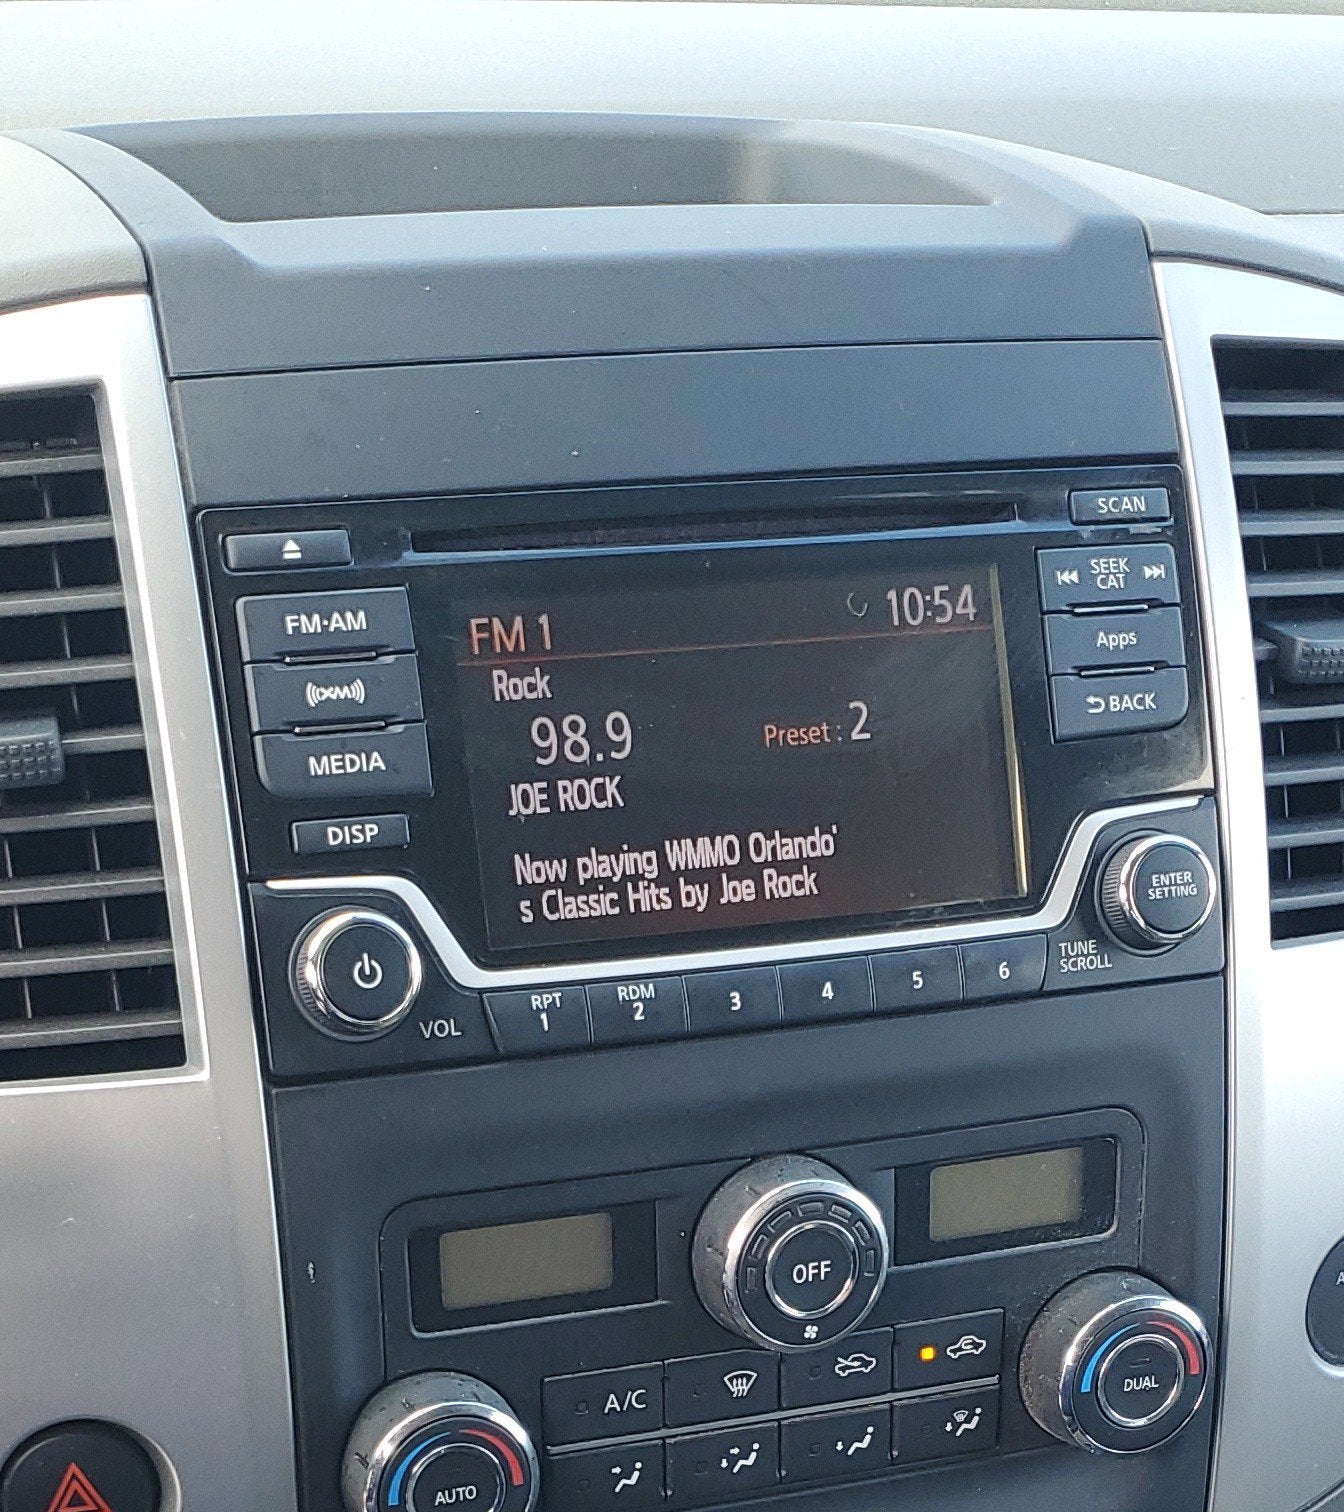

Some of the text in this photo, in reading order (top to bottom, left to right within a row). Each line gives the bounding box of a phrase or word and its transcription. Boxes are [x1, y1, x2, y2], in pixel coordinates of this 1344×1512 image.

[1097, 496, 1146, 513] SCAN
[1090, 558, 1129, 574] SEEK
[1097, 573, 1125, 590] CAT
[887, 584, 977, 626] 10:54
[469, 614, 552, 654] FM 1
[1096, 630, 1137, 649] Apps
[492, 666, 553, 701] Rock
[1109, 692, 1156, 711] BACK
[849, 701, 872, 741] 2
[531, 711, 633, 765] 98.9
[308, 751, 386, 777] MEDIA
[509, 775, 624, 817] JOE ROCK
[327, 825, 379, 845] DISP
[514, 851, 566, 886] Now
[577, 846, 658, 881] playing
[665, 838, 740, 871] WMMO
[1152, 872, 1192, 886] ENTER
[520, 865, 819, 923] s Classic Hits by Joe Rock
[1148, 883, 1197, 899] SETTING
[1059, 940, 1097, 957] TUNE
[998, 961, 1010, 981] 6
[1059, 954, 1112, 973] SCROLL
[913, 971, 923, 990] 5
[617, 983, 655, 1001] RDM
[821, 981, 834, 1001] 4
[531, 993, 562, 1010] RPT
[633, 1001, 645, 1021] 2
[730, 992, 741, 1011] 3
[420, 1019, 462, 1039] VOL
[541, 1013, 549, 1031] 1
[792, 1260, 832, 1285] OFF
[1123, 1374, 1160, 1392] DUAL
[603, 1388, 648, 1413] A/C
[434, 1485, 477, 1507] AUTO
